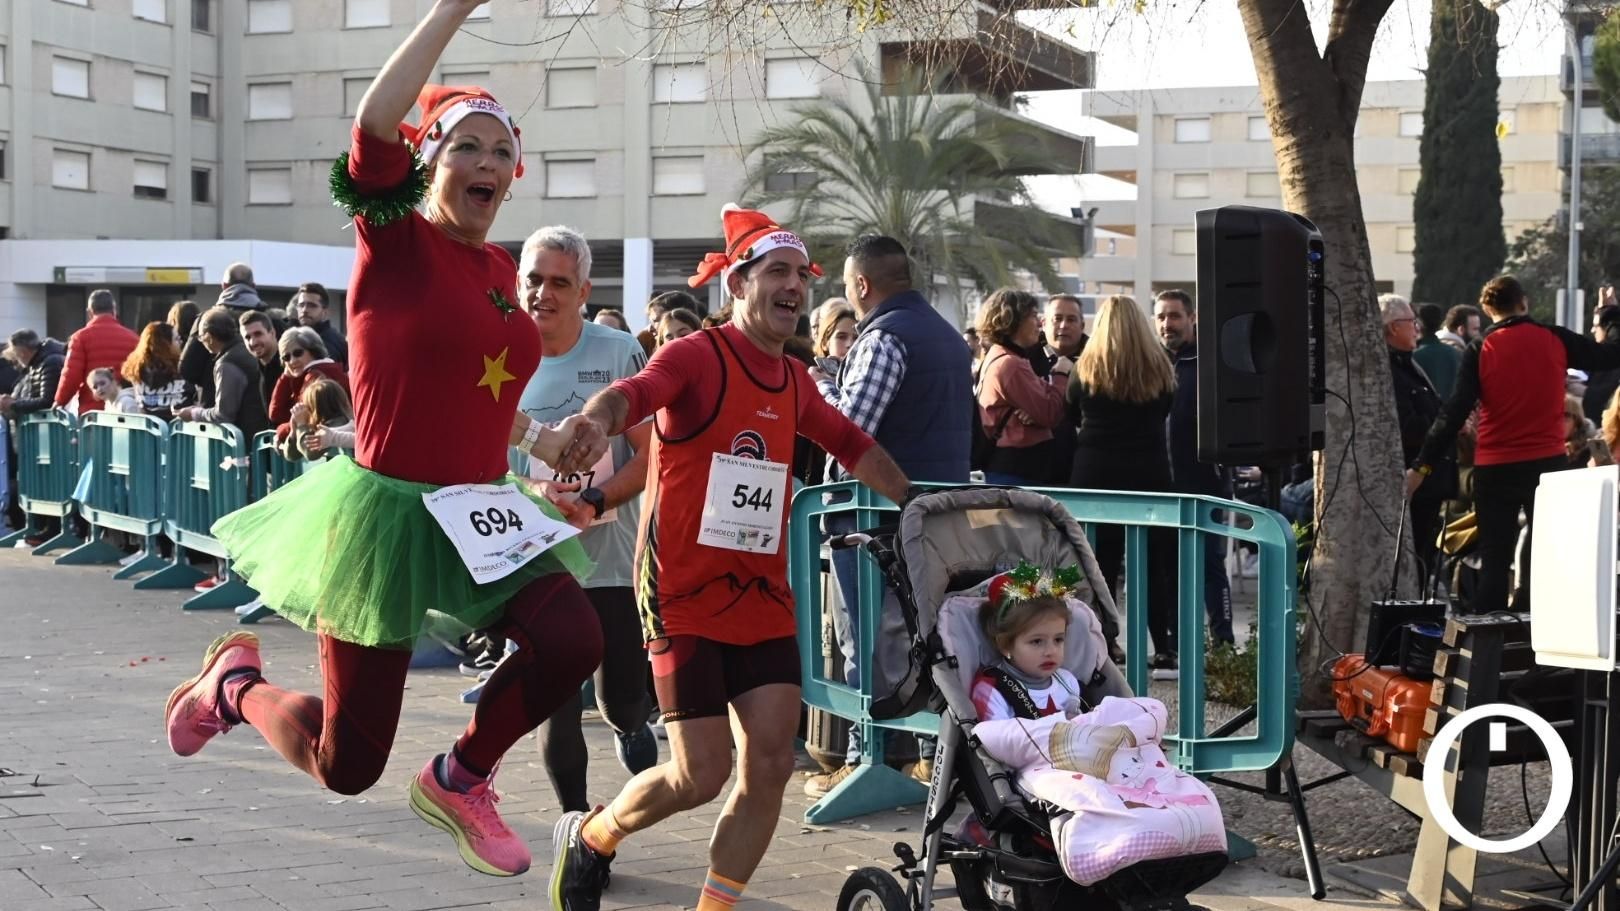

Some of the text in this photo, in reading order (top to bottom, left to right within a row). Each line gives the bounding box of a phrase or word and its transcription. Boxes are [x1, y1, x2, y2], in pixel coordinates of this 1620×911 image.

[732, 483, 773, 513] 544
[469, 507, 523, 537] 694
[568, 814, 585, 849] HOKA
